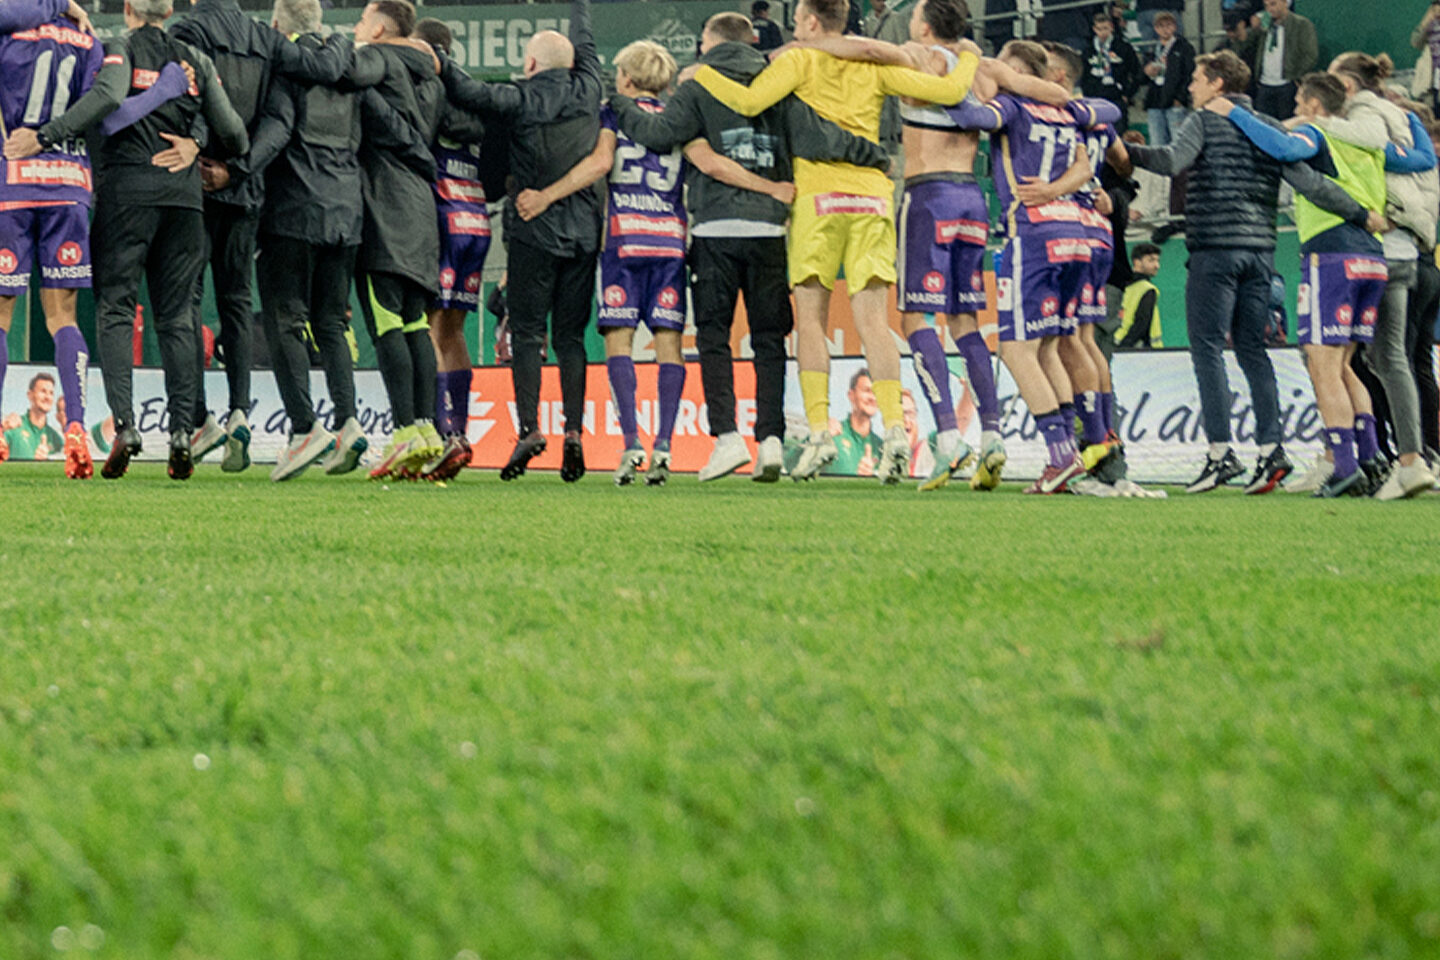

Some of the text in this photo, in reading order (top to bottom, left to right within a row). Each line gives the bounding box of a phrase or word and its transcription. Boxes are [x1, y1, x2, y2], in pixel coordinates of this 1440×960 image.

[23, 49, 77, 124] 11
[609, 132, 682, 192] 23
[1028, 123, 1077, 183] 77
